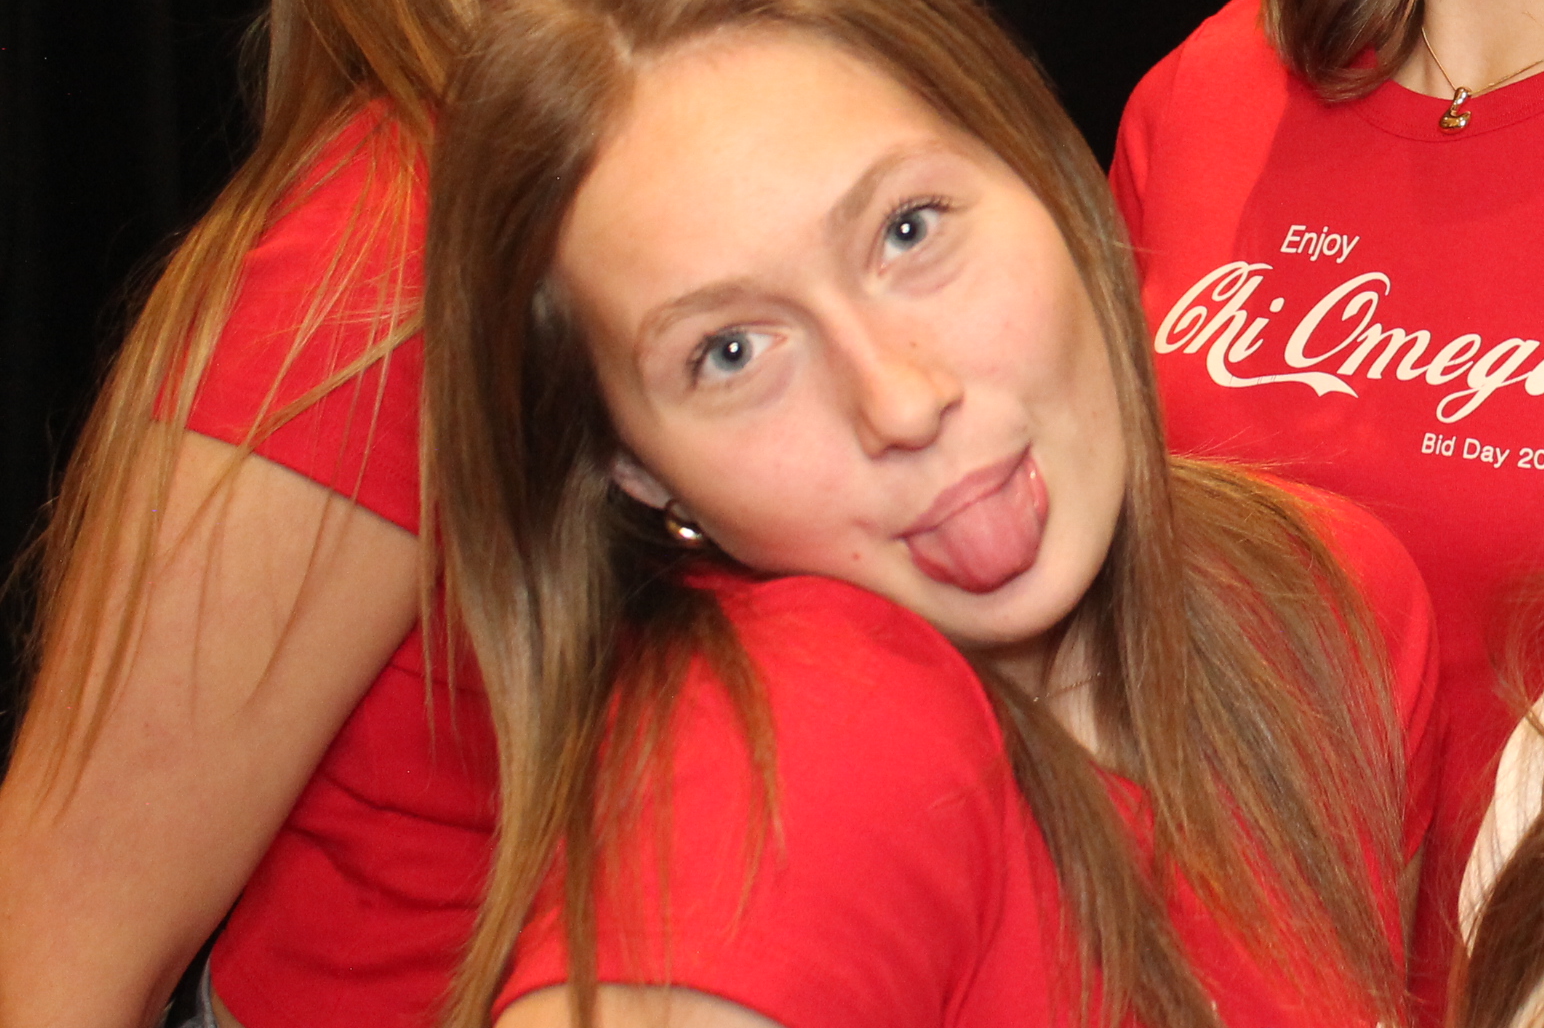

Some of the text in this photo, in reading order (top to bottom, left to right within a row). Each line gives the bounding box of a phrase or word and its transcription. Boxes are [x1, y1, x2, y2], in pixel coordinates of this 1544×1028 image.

[1281, 224, 1360, 264] Enjoy
[1154, 261, 1290, 392] Chi
[1421, 432, 1457, 457] Bid
[1463, 437, 1511, 469] Day
